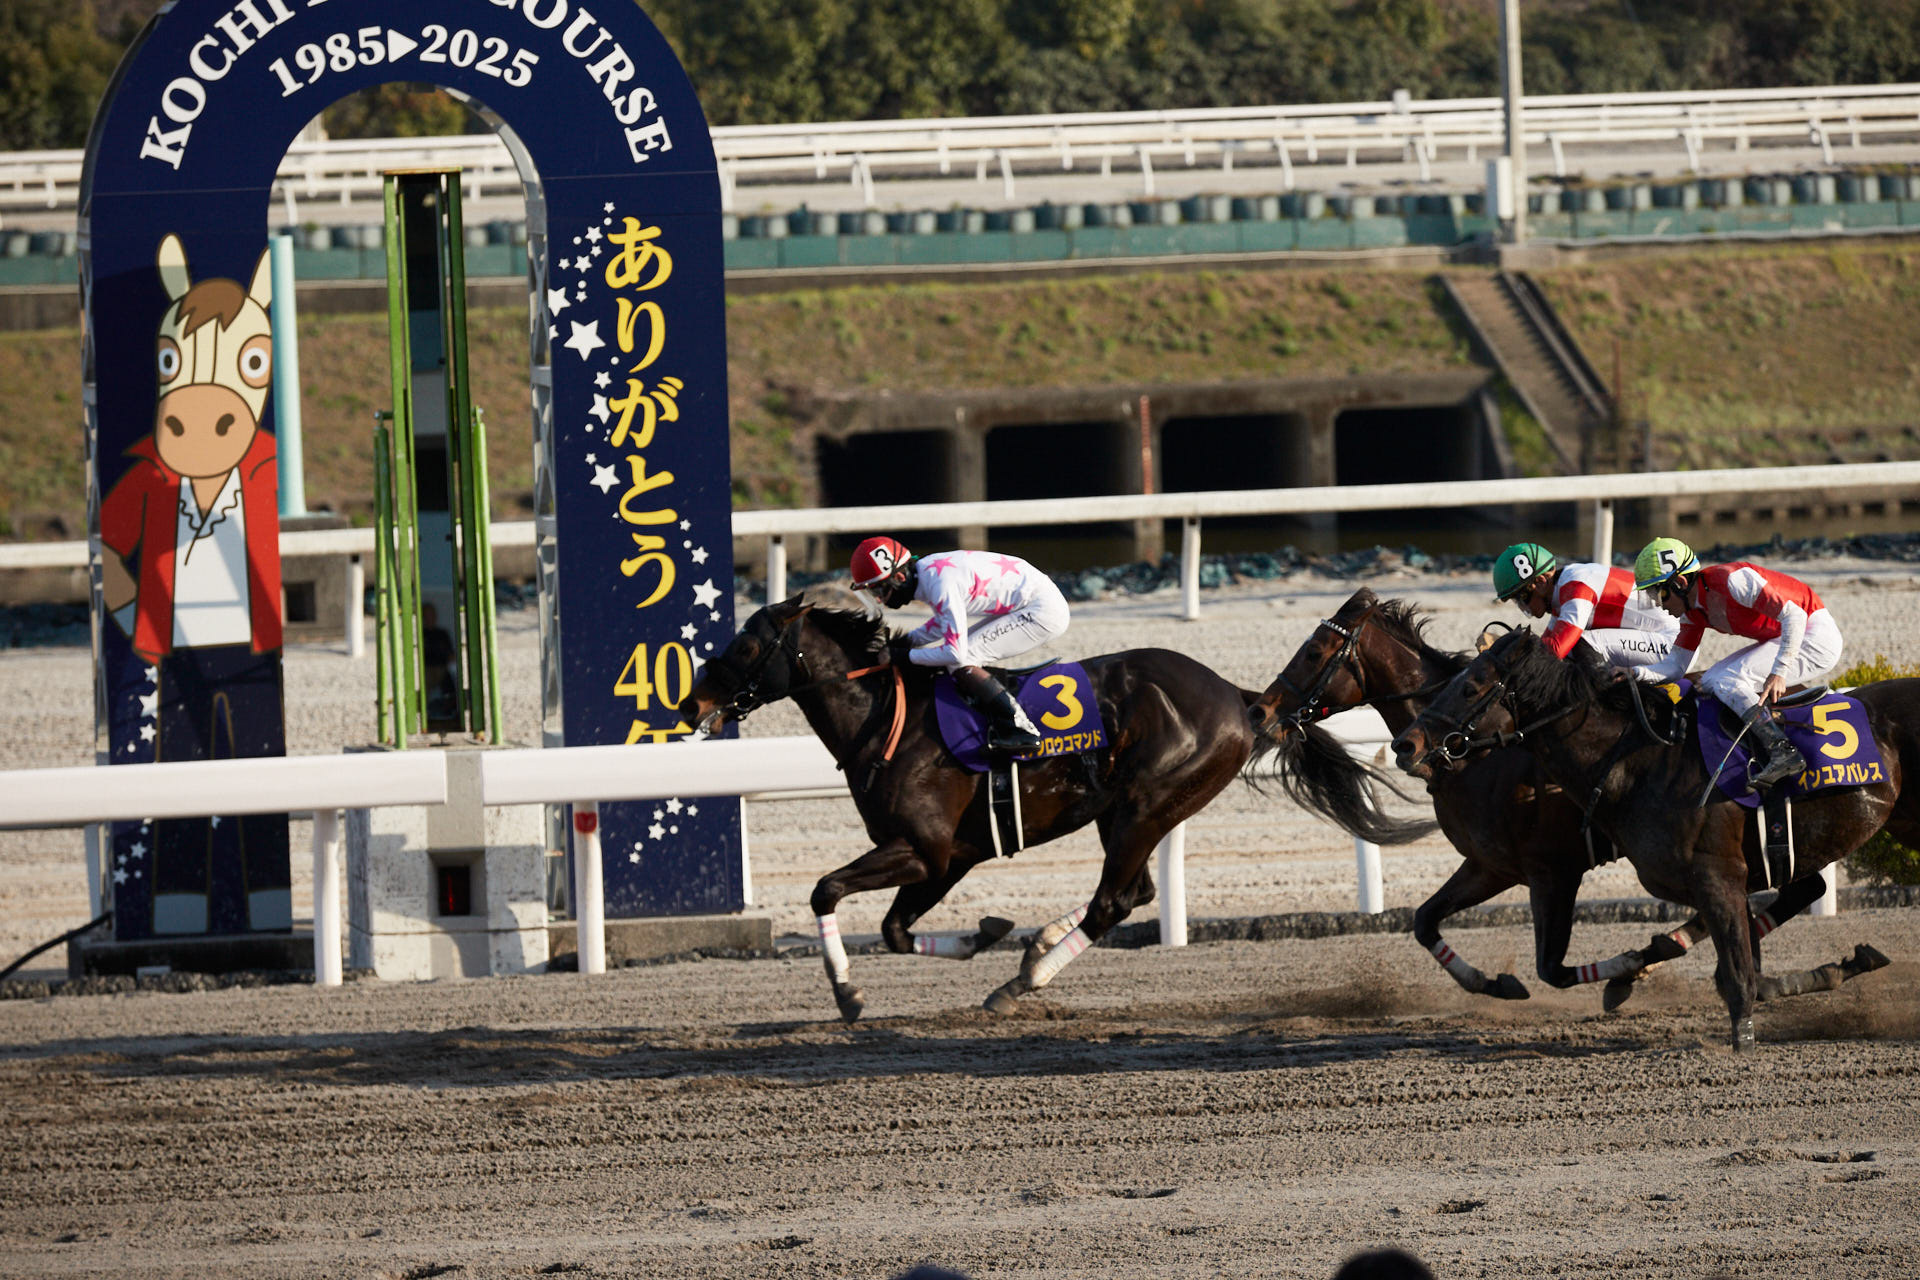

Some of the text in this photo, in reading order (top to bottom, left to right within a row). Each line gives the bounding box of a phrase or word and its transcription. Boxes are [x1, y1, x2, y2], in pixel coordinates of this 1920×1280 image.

[139, 0, 673, 171] KOCHI OURSE
[268, 24, 540, 98] 1985 2025
[604, 216, 684, 609] ありがとう
[875, 548, 894, 571] 3
[1513, 553, 1534, 580] 8
[1659, 549, 1678, 574] 5
[1039, 674, 1084, 730] 3
[1812, 702, 1859, 760] 5
